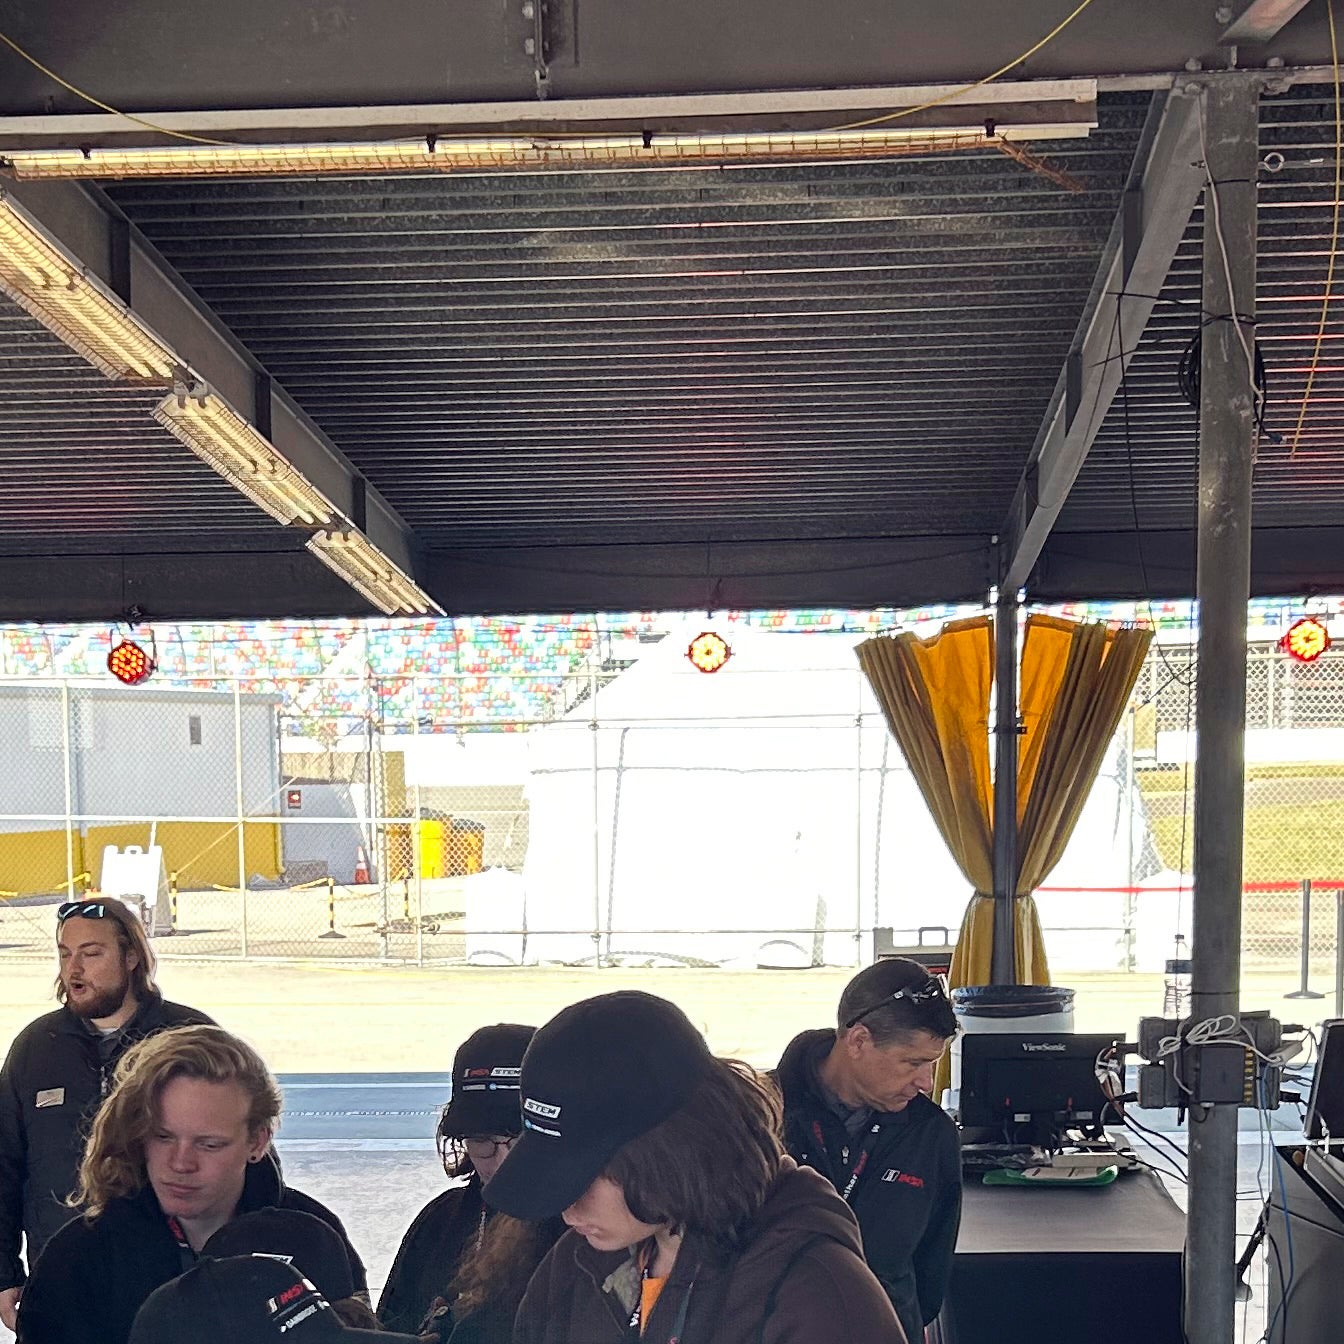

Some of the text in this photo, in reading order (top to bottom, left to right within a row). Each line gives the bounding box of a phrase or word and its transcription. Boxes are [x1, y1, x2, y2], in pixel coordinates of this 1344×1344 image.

[1022, 1042, 1068, 1052] ViewSonic
[494, 1068, 522, 1076] STEM
[526, 1101, 557, 1115] STEM
